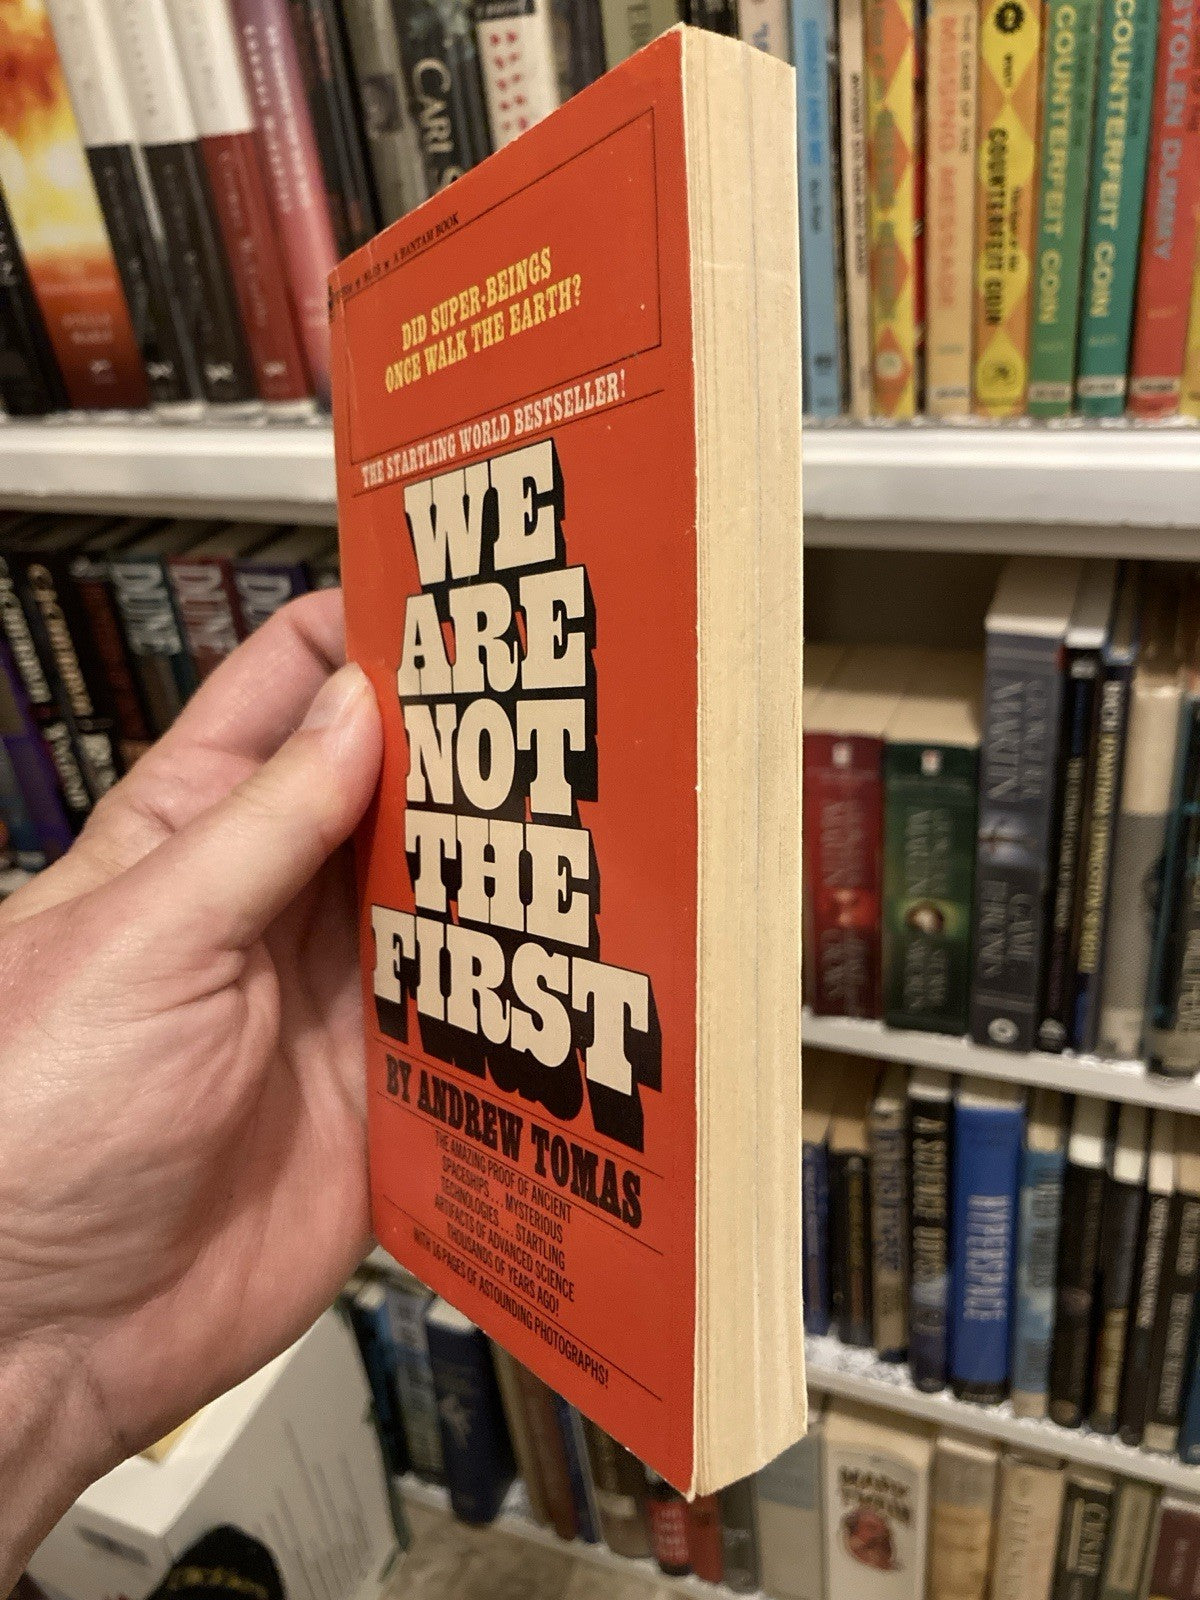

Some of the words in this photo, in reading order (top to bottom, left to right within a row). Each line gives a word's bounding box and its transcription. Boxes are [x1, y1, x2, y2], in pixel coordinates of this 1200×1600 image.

[1045, 4, 1078, 239] COUNTERFEIT
[1096, 0, 1136, 231] COUNTERFEIT
[399, 230, 434, 260] BANTAM
[435, 212, 459, 235] BOOK
[1040, 248, 1061, 324] COIN
[1089, 241, 1116, 318] COIN
[385, 353, 422, 393] ONCE
[425, 330, 468, 376] WALK
[471, 311, 505, 353] THE
[509, 274, 582, 337] EARTH?
[401, 314, 428, 351] DID
[431, 246, 552, 336] SUPER-BEINGS
[361, 461, 385, 488] THE
[386, 432, 457, 483] STARTLING
[458, 413, 511, 452] WORLD
[514, 368, 626, 436] BESTSELLER!
[403, 438, 557, 587] WE
[111, 563, 182, 656] DUNE
[169, 564, 240, 657] DUNE
[235, 574, 292, 625] DU
[397, 565, 586, 697] ARE
[403, 698, 586, 817] NOT
[404, 808, 590, 948] THE
[370, 904, 650, 1097] FIRST
[386, 1053, 412, 1103] BY
[417, 1070, 524, 1162] ANDREW
[531, 1123, 643, 1229] TOMAS
[435, 1129, 450, 1152] THE
[451, 1137, 487, 1174] AMAZING
[488, 1159, 516, 1190] PROOF
[517, 1176, 530, 1198] OF
[531, 1185, 572, 1224] ANCIENT
[912, 1115, 946, 1134] A
[434, 1193, 475, 1234] ARTIFACTS
[476, 1220, 487, 1240] OF
[488, 1228, 534, 1274] ADVANCED
[535, 1259, 576, 1303] SCIENCE
[447, 1221, 494, 1269] THOUSANDS
[494, 1255, 506, 1277] OF
[508, 1265, 536, 1299] YEARS
[537, 1285, 560, 1318] AGO!
[505, 1192, 564, 1245] MYSTERIOUS
[515, 1222, 566, 1271] STARTLING
[963, 1194, 1012, 1321] HYPERSPACE
[413, 1226, 432, 1252] WITH
[442, 1247, 466, 1279] PAGES
[467, 1266, 477, 1287] OF
[478, 1274, 533, 1331] ASTOUNDING
[534, 1320, 609, 1390] PHOTOGRAPHS!
